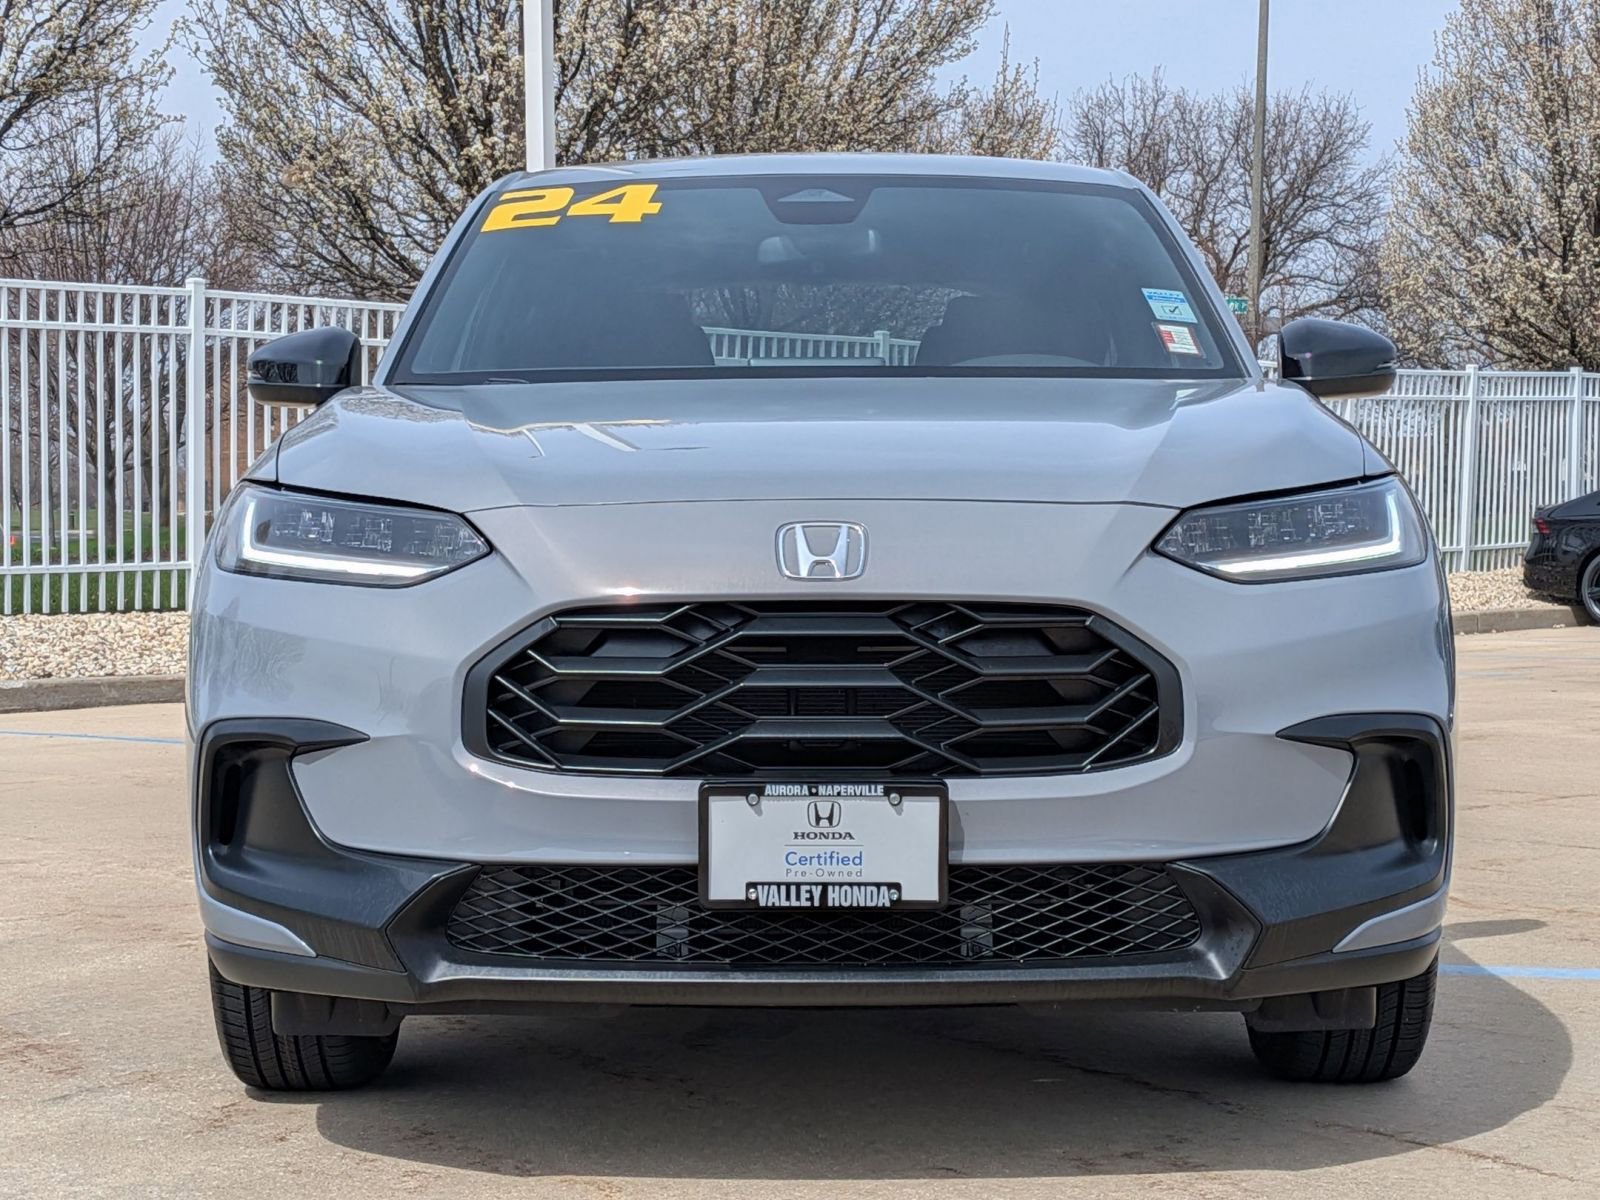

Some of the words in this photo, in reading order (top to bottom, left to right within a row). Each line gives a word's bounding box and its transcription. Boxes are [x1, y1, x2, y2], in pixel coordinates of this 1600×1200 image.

[480, 184, 663, 232] 24
[765, 785, 809, 796] AURORA
[818, 785, 884, 796] NAPERVILLE
[793, 832, 855, 840] HONDA
[785, 851, 863, 866] Certified
[786, 869, 863, 878] Pre-Owned
[757, 885, 822, 906] VALLEY
[828, 886, 890, 907] HONDA
